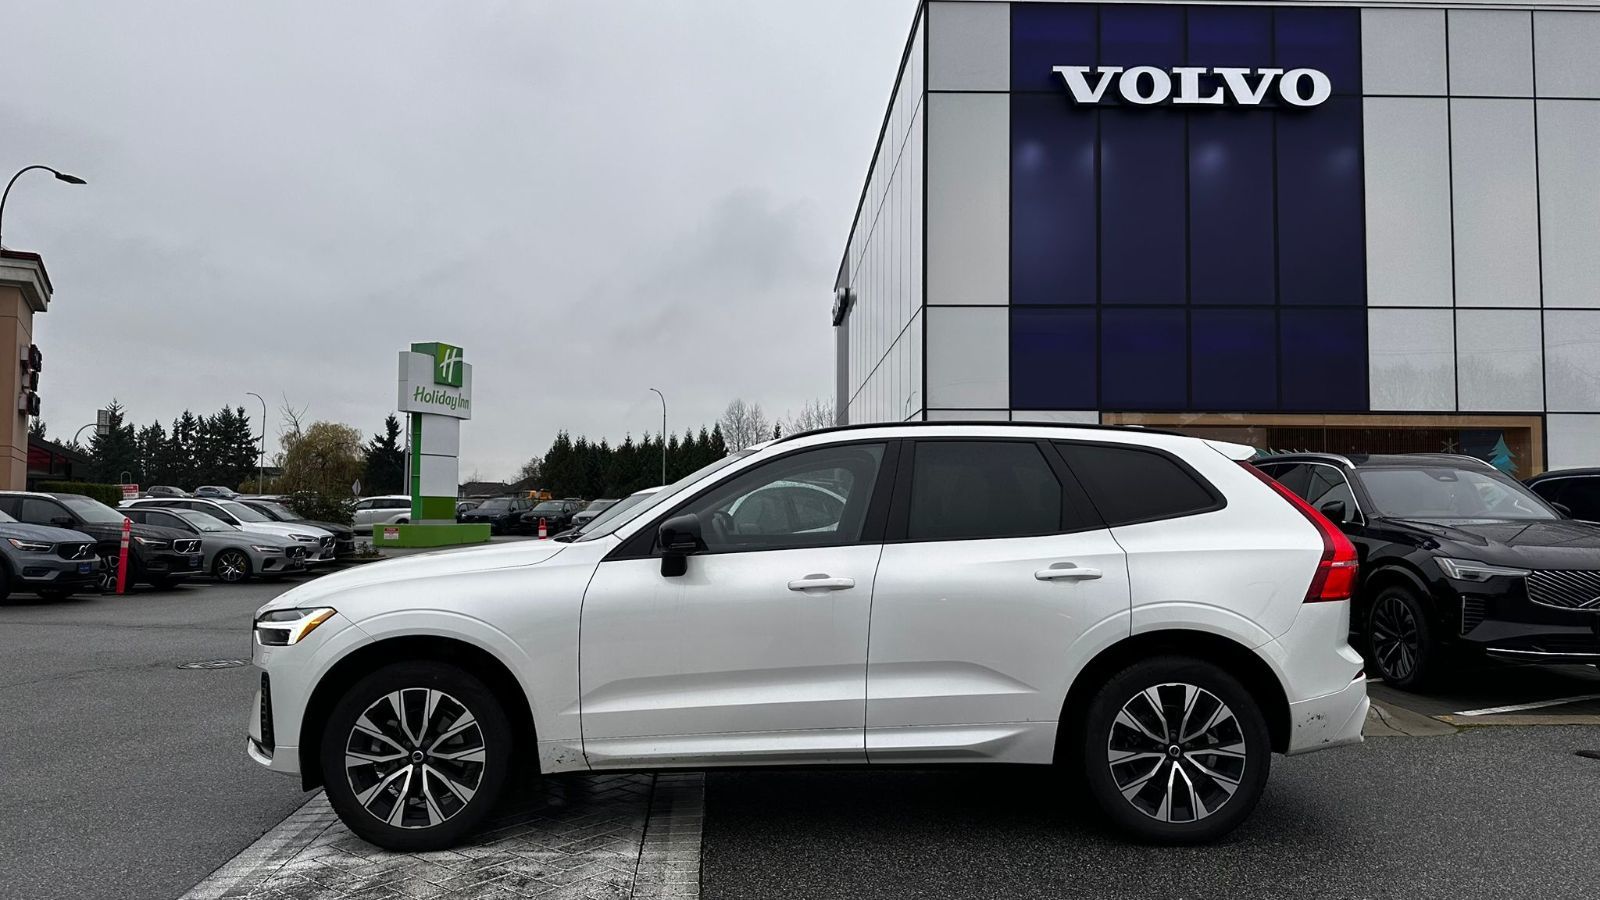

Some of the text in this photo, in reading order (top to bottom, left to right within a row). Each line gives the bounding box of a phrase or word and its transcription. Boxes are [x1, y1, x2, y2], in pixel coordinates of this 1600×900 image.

[1052, 65, 1332, 106] VOLVO
[440, 348, 463, 383] H
[413, 385, 470, 411] Holiday Inn
